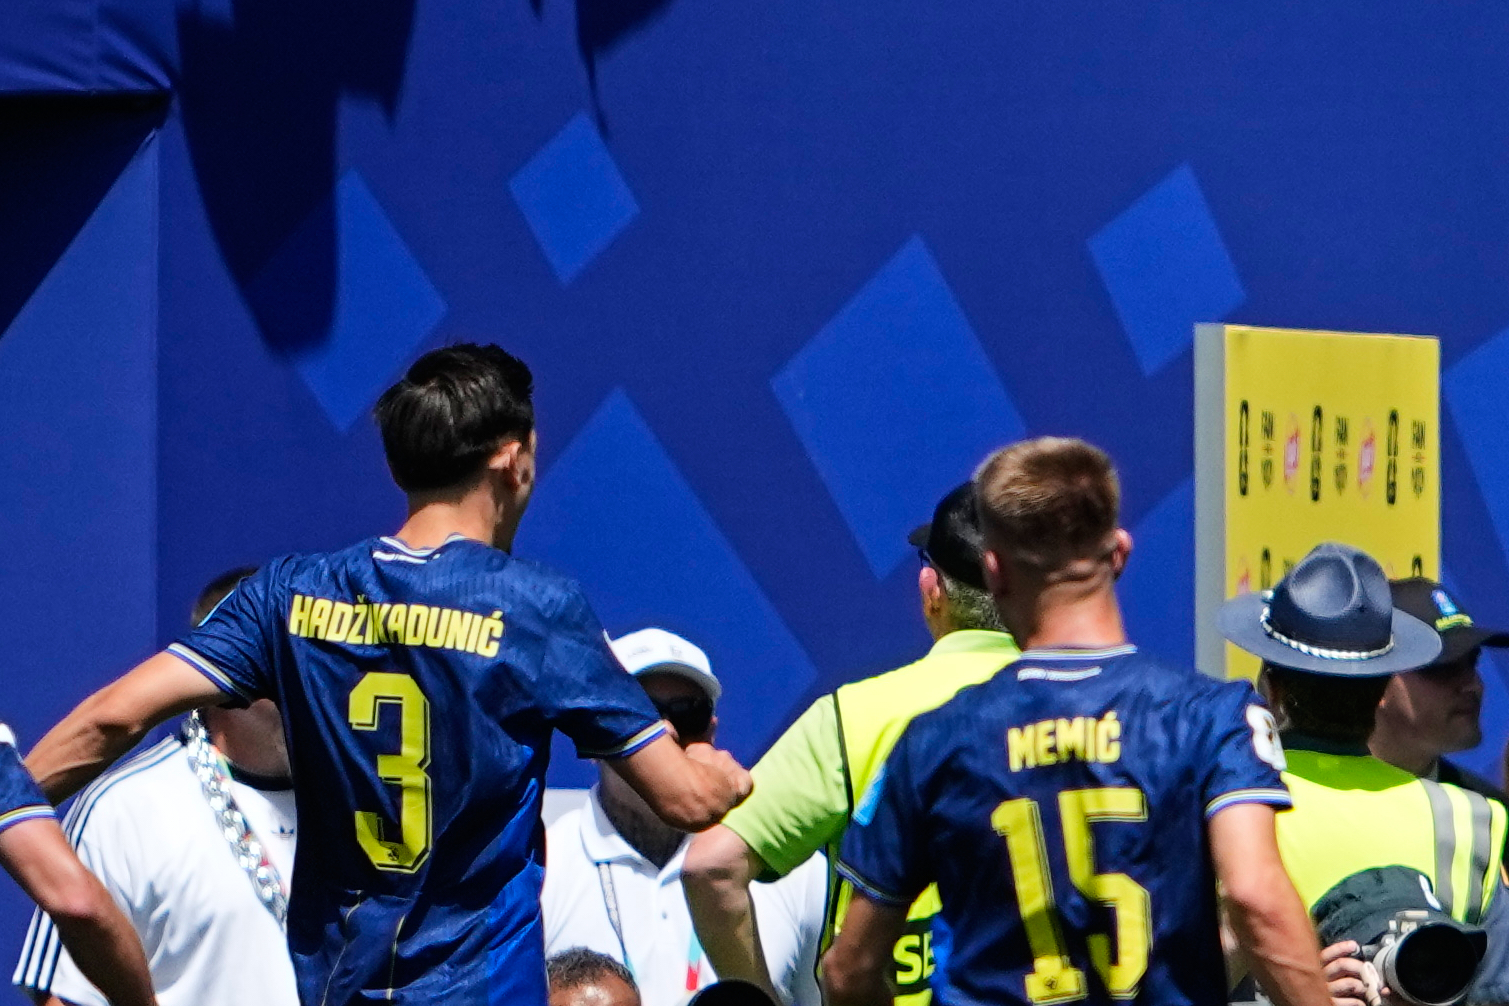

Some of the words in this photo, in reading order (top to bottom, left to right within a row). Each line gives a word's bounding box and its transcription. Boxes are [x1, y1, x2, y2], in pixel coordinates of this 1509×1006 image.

[289, 594, 504, 658] HADŽIKADUNIĆ
[348, 672, 432, 874] 3
[1008, 711, 1121, 772] MEMIĆ
